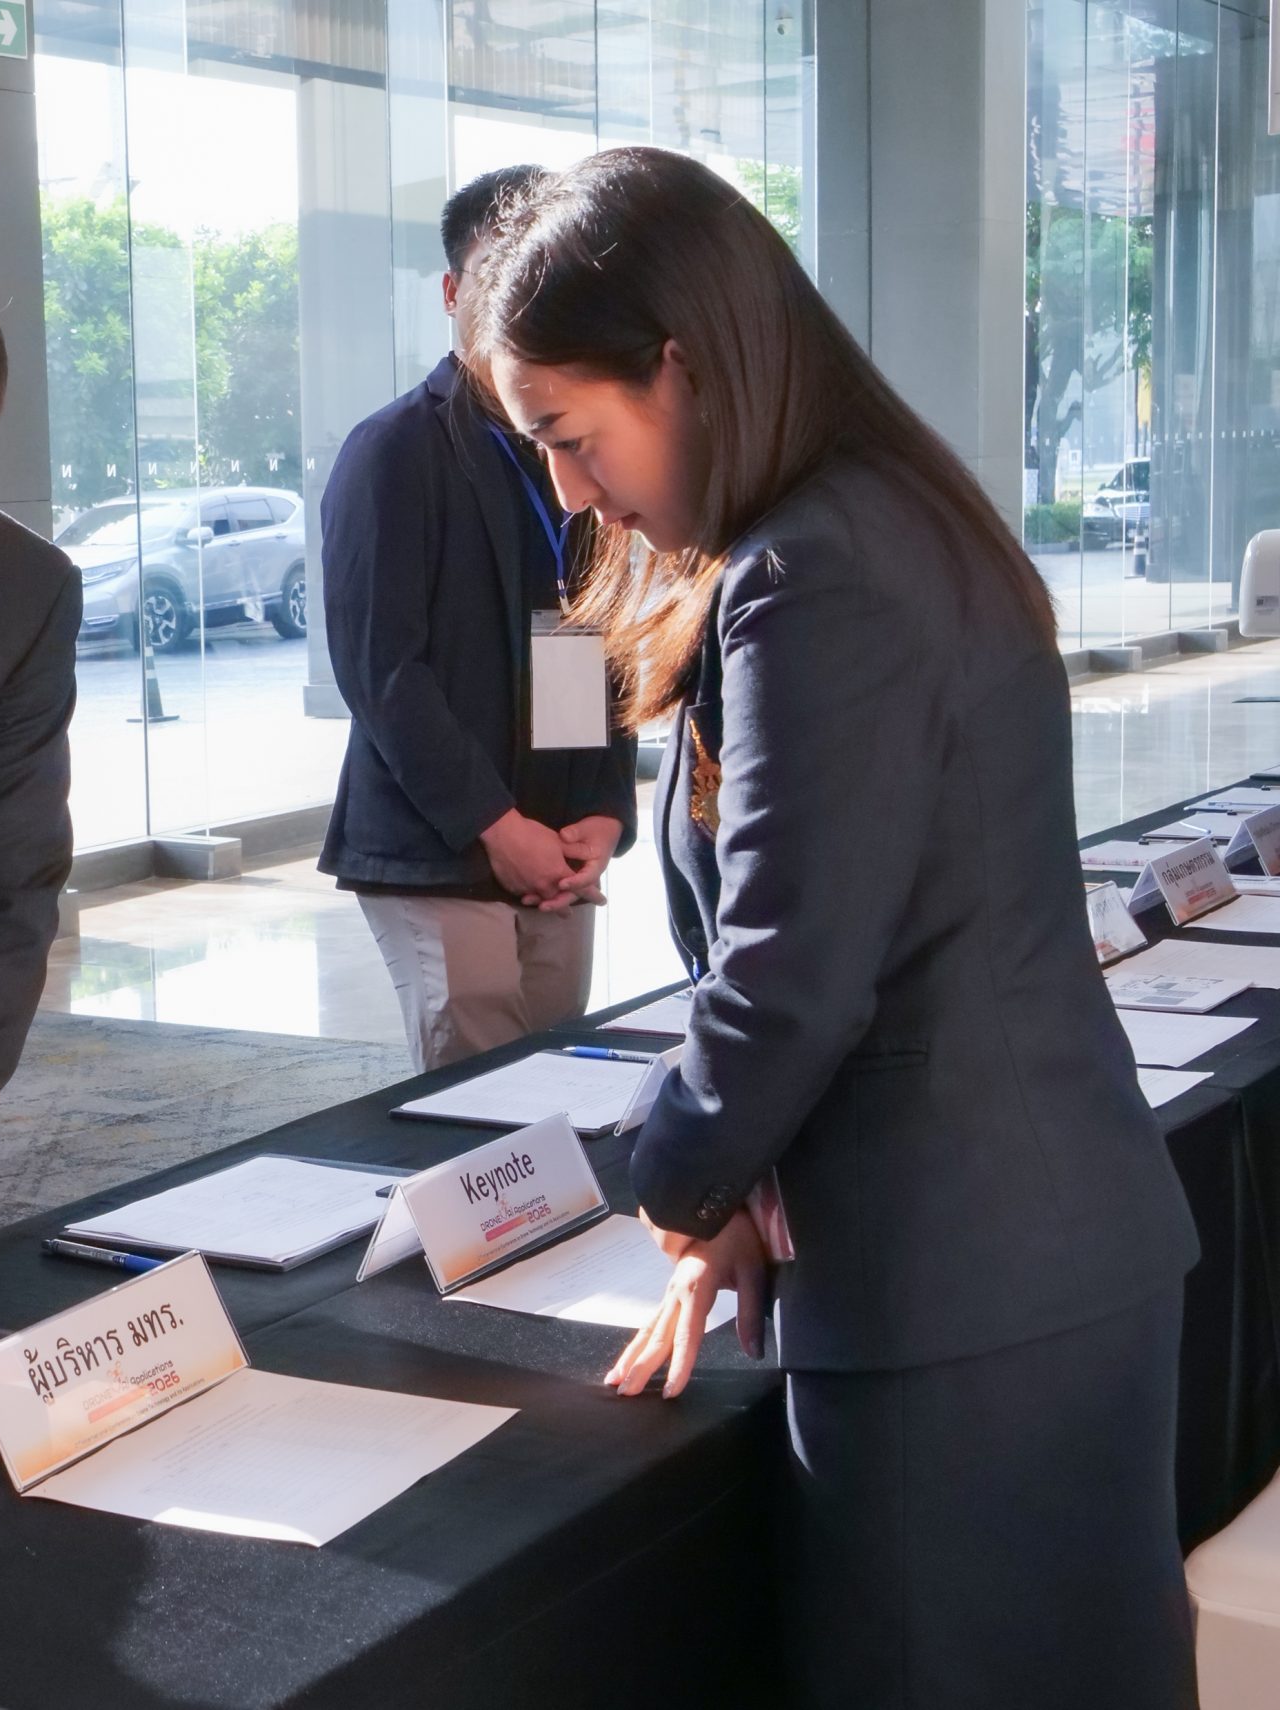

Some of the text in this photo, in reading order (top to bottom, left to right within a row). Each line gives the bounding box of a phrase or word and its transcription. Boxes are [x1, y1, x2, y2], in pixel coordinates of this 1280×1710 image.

[459, 1152, 535, 1205] Keynote
[480, 1215, 503, 1232] DRONE
[514, 1194, 546, 1214] Applications
[526, 1203, 552, 1224] 2026
[24, 1304, 185, 1405] ผู้บริหาร มทร.
[146, 1370, 181, 1397] 2026
